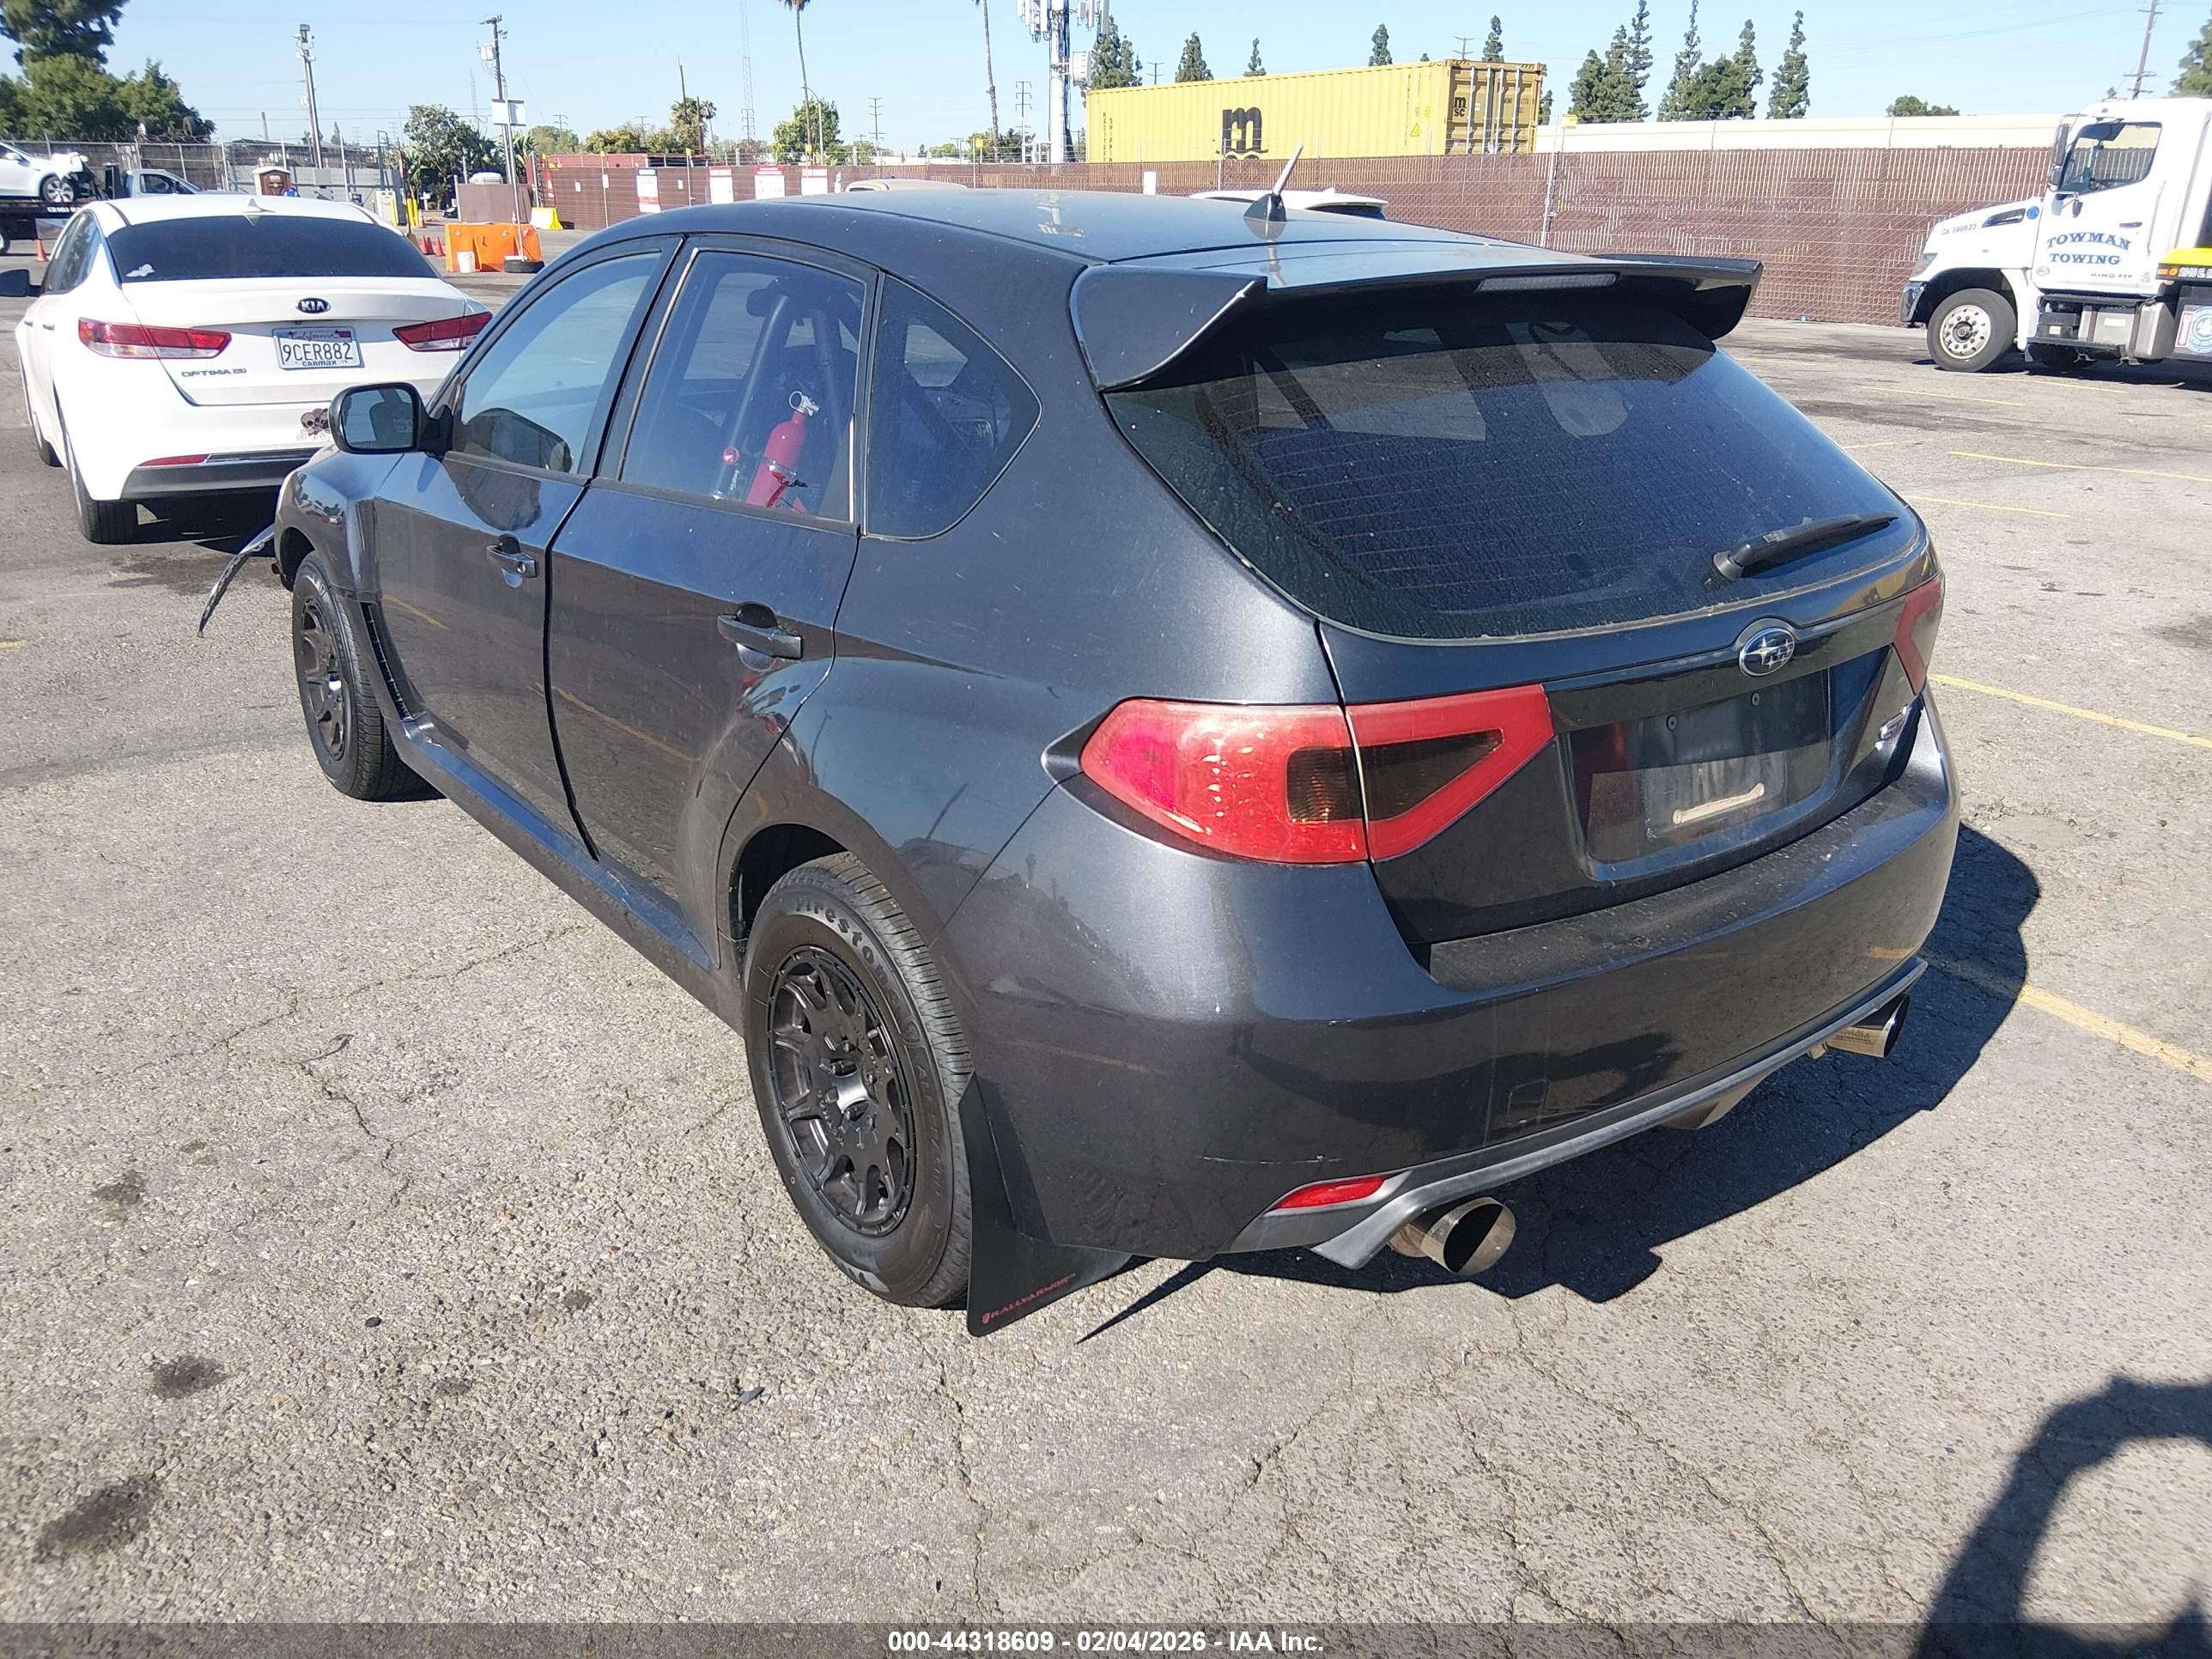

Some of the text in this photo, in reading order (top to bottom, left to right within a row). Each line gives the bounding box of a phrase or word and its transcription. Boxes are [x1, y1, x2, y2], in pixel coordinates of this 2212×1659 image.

[2047, 232, 2132, 250] TOWMAN
[2050, 253, 2121, 265] TOWING
[301, 301, 325, 312] KIA
[290, 331, 338, 342] California
[283, 343, 354, 362] 9CER882
[181, 368, 232, 378] OPTIMA
